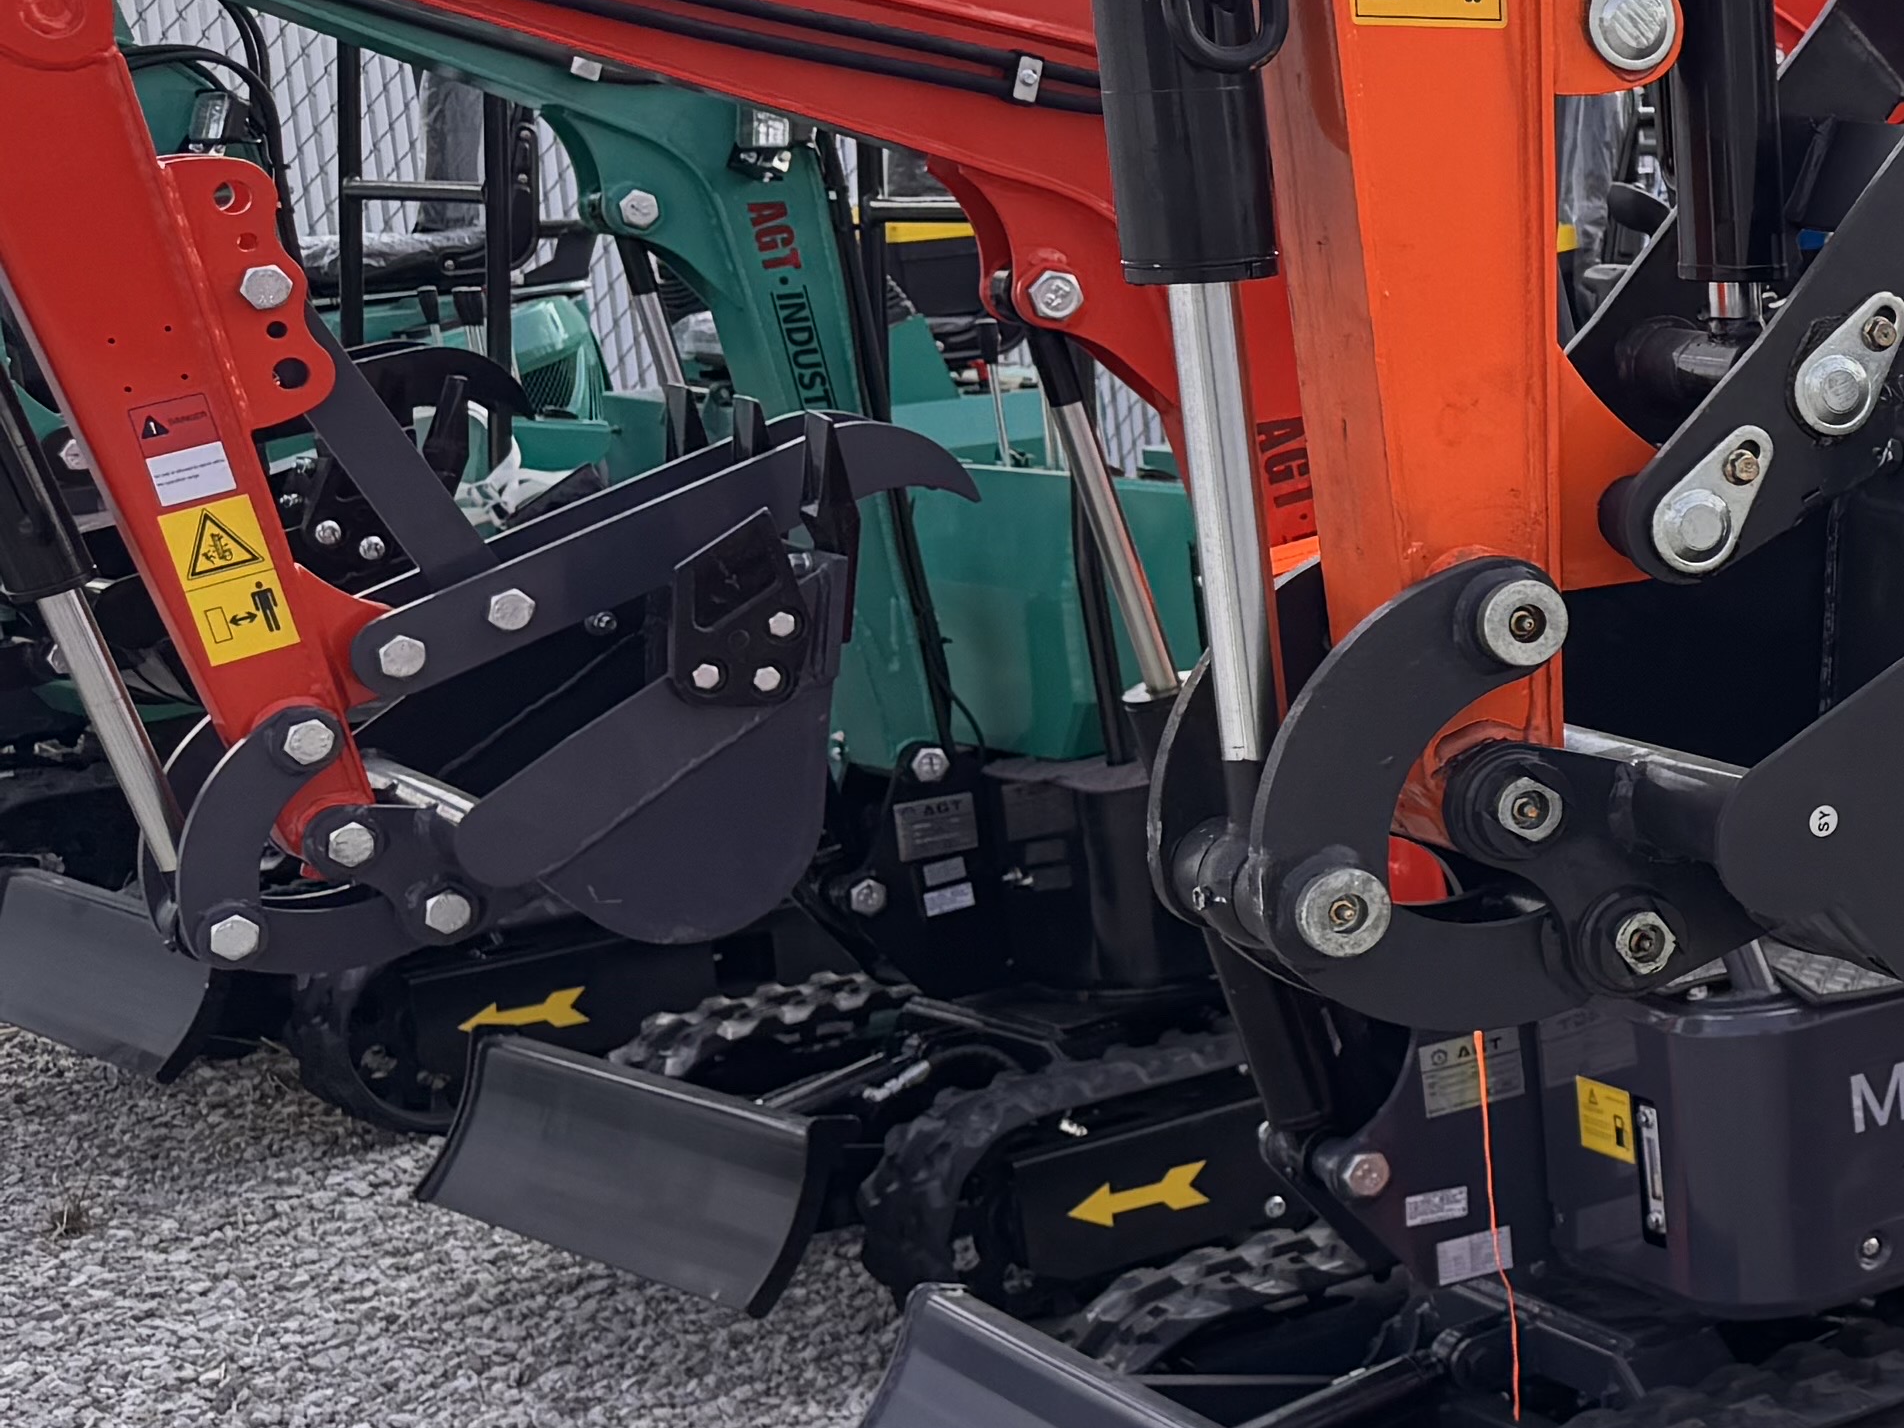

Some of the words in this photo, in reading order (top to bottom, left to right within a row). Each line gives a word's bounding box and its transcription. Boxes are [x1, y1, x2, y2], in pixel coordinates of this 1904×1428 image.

[747, 200, 803, 271] AGT
[923, 799, 963, 817] AGT
[1818, 811, 1831, 832] SY
[1457, 1036, 1502, 1060] AT
